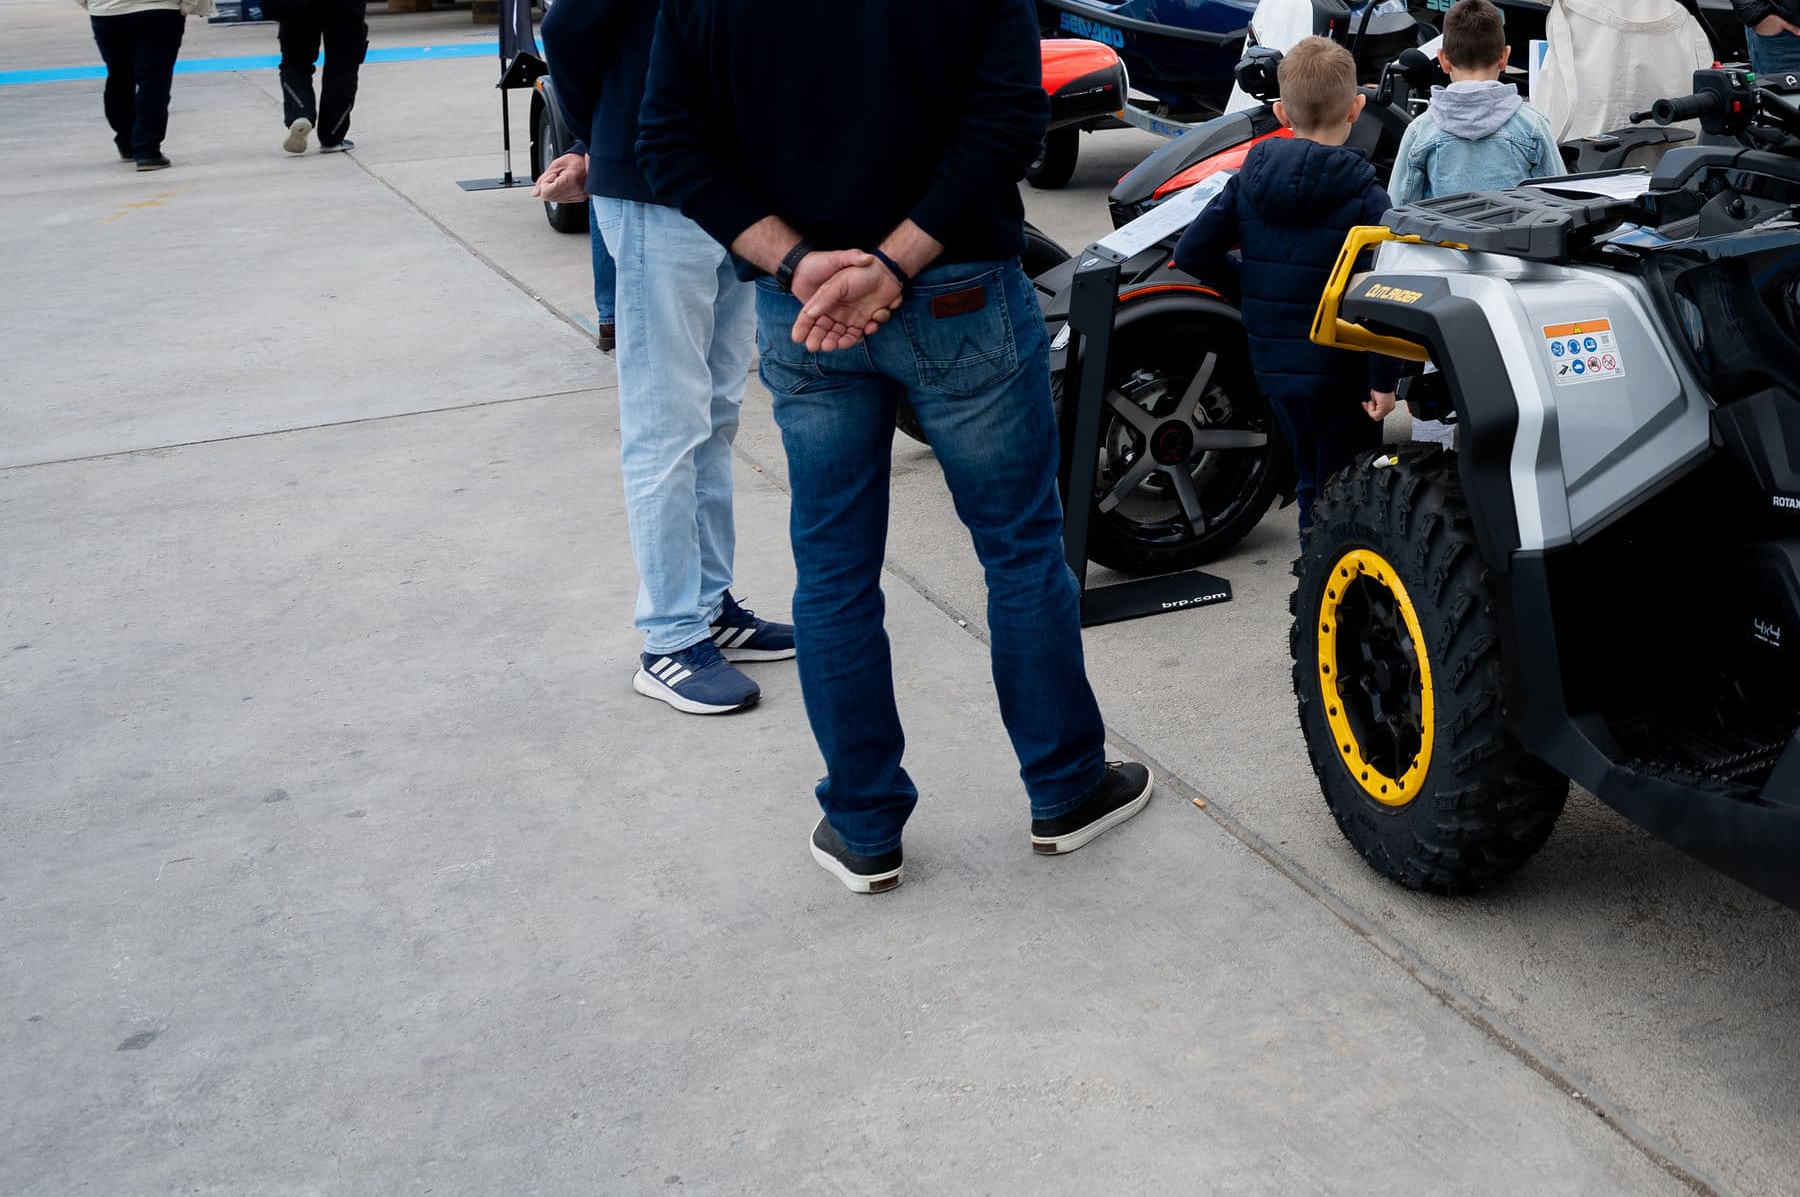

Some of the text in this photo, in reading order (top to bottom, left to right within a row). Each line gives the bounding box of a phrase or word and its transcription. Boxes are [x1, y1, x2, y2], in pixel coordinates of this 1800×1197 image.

[1364, 283, 1424, 305] OUTLANDER
[1161, 591, 1228, 609] brp.com
[1754, 618, 1781, 640] 4x4
